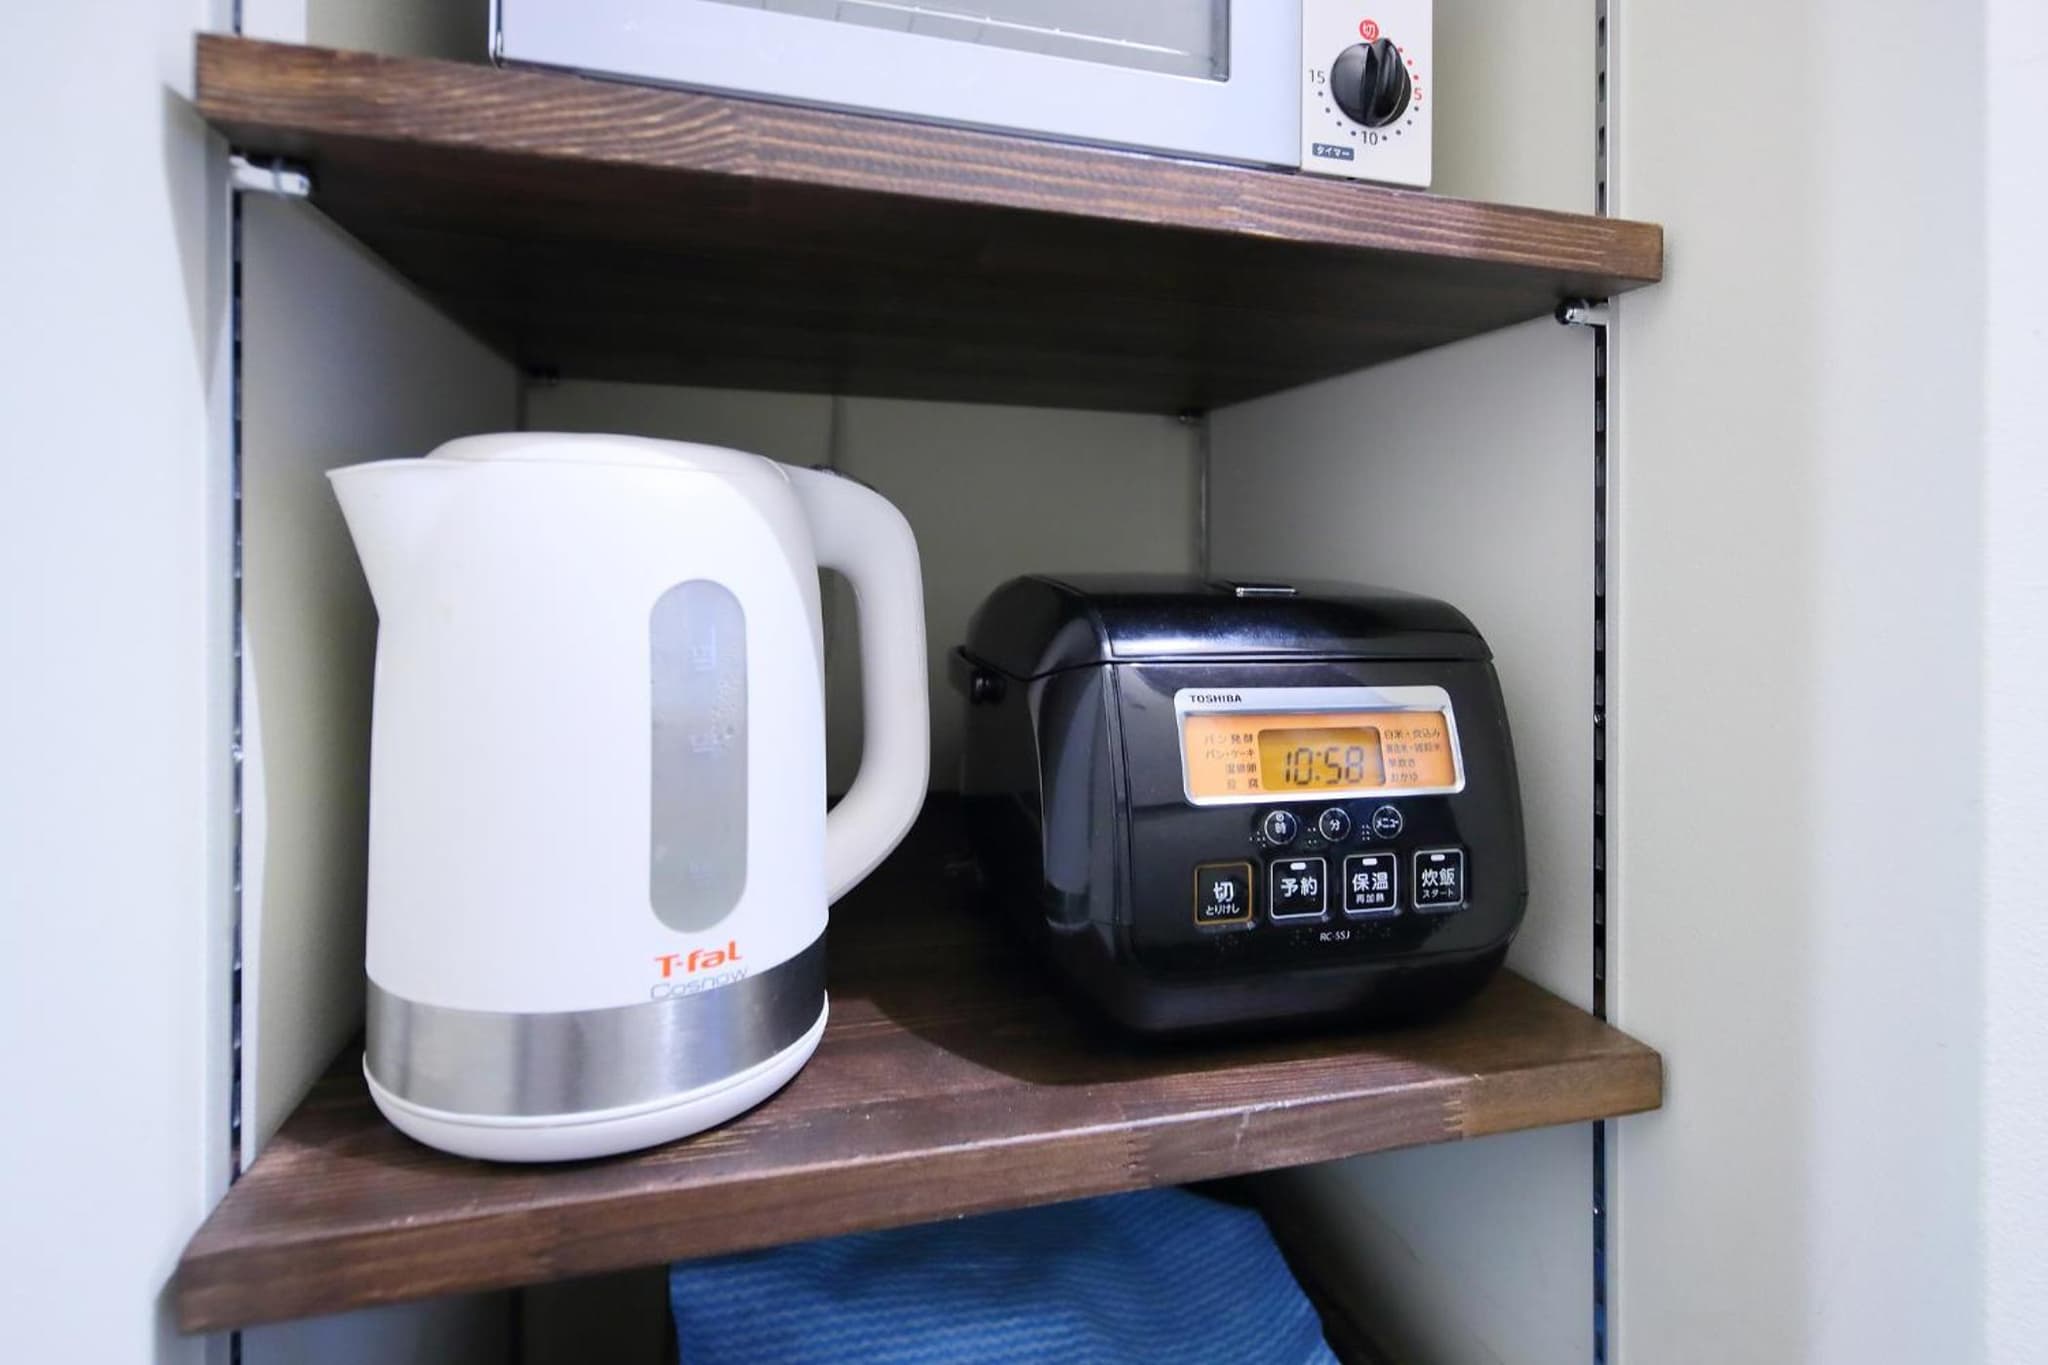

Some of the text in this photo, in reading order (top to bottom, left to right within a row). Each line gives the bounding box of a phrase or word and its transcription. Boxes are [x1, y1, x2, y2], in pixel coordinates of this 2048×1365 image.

[1309, 70, 1325, 84] 15
[1414, 87, 1422, 101] 5
[1361, 131, 1378, 145] 10
[1316, 146, 1351, 158] タイマー
[1190, 694, 1243, 704] TOSHIBA
[1283, 747, 1364, 785] 10:58
[1329, 819, 1341, 832] 分
[1376, 817, 1399, 829] メニュー
[1352, 872, 1389, 892] 保温
[1421, 868, 1455, 888] 炊飯
[1213, 881, 1234, 903] 切
[1280, 876, 1318, 898] 予約
[1422, 888, 1454, 899] スタート
[1205, 903, 1240, 916] とりけし
[654, 940, 742, 977] T-fal
[650, 968, 748, 1000] Cosnow
